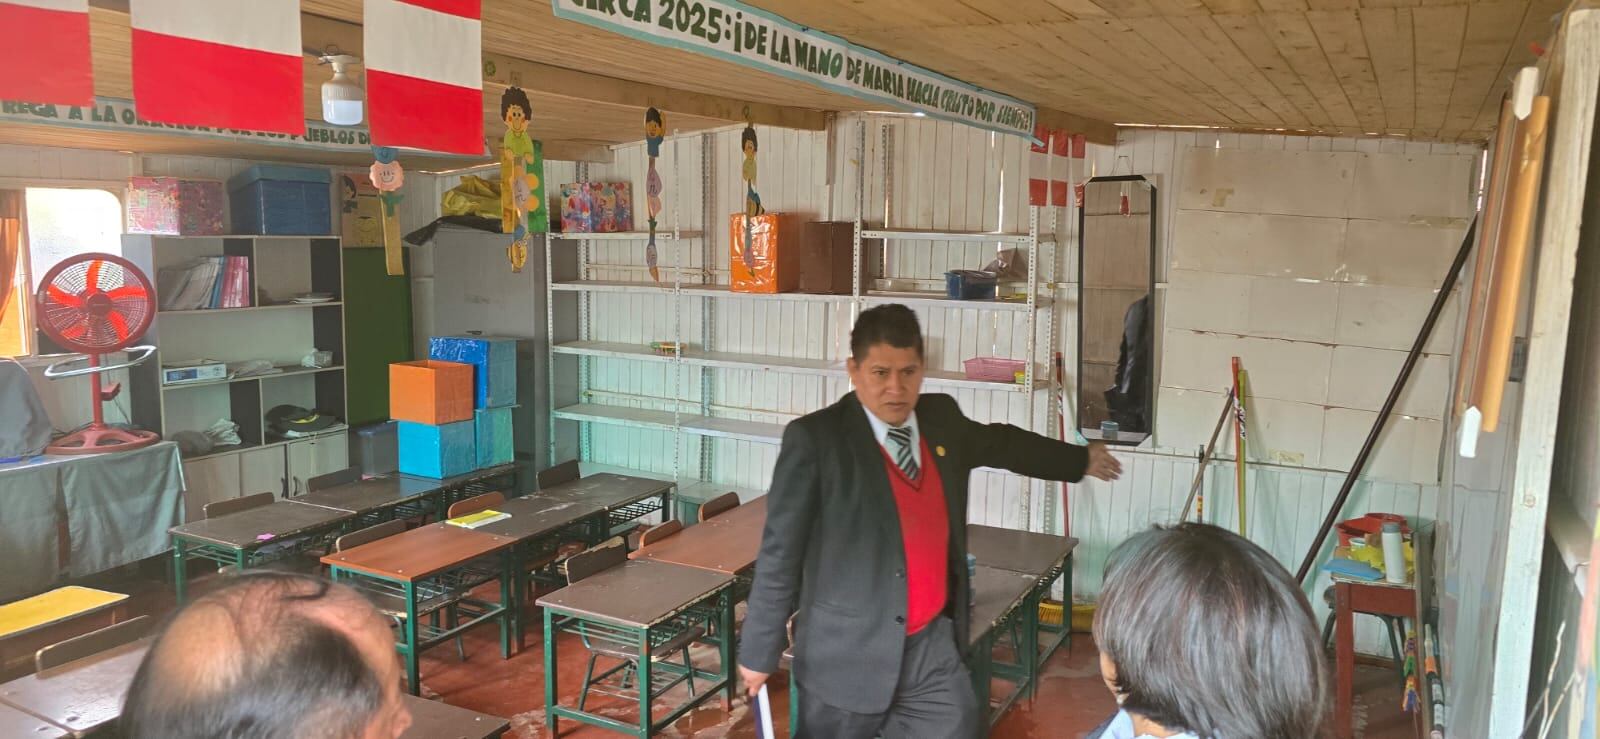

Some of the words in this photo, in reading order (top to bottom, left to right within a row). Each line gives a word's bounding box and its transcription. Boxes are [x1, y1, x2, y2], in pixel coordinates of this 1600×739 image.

[770, 30, 792, 65] LA
[794, 38, 844, 78] MANO
[846, 56, 862, 85] DE
[863, 63, 904, 98] MARIA
[906, 77, 940, 109] HACIA
[941, 89, 974, 116] CRISTO
[975, 98, 995, 122] POR
[69, 105, 83, 120] A
[91, 105, 117, 123] LA
